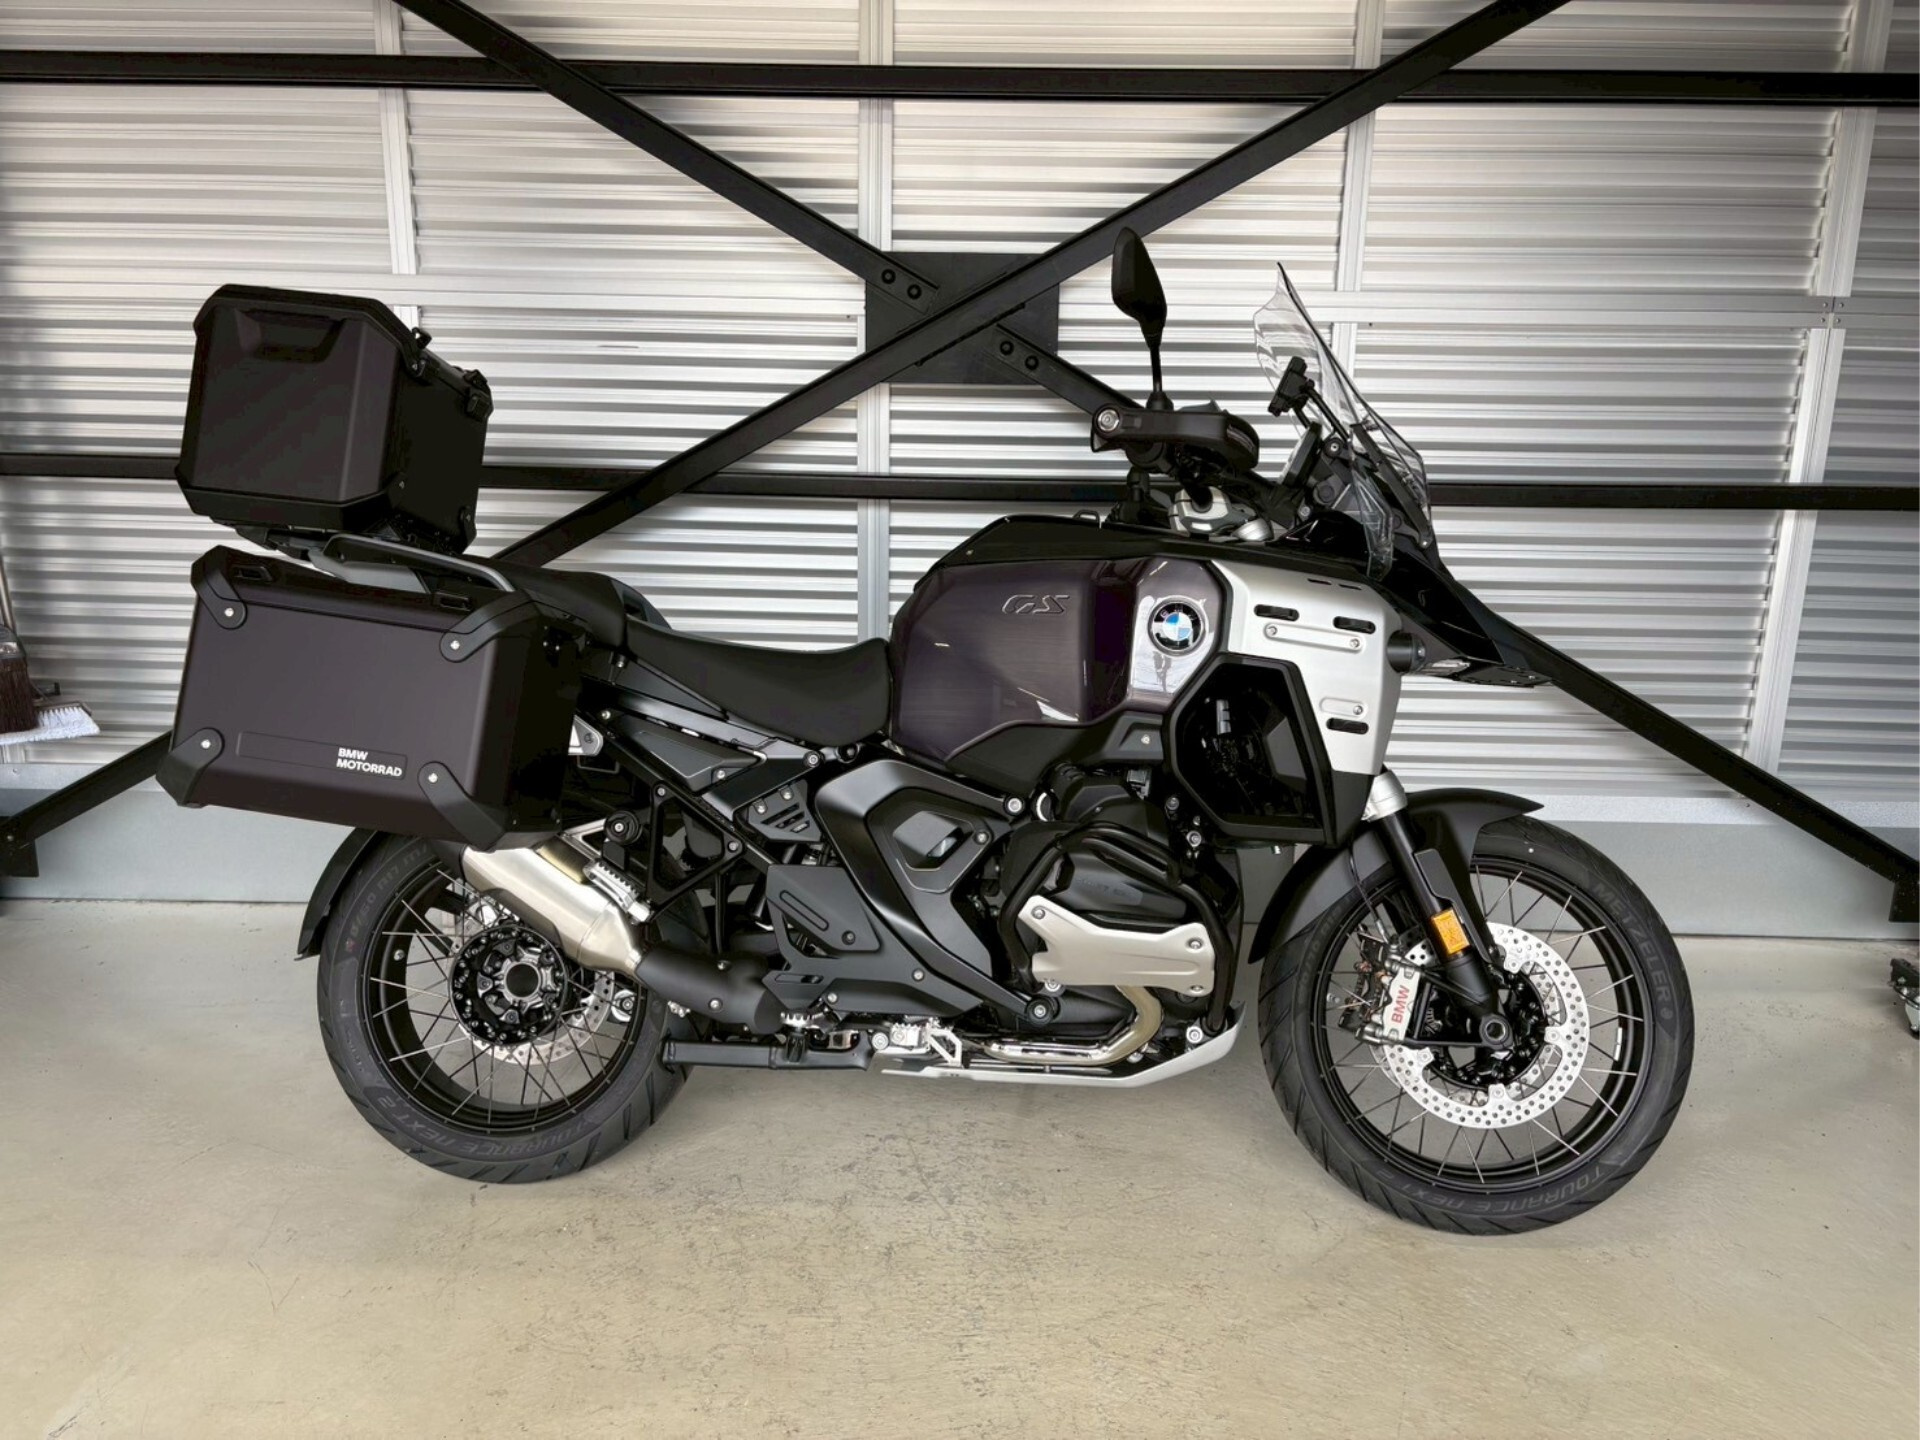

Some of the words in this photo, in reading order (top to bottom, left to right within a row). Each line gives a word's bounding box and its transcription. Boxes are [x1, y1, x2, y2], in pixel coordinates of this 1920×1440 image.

[1002, 594, 1070, 614] GS
[336, 758, 402, 777] MOTORRAD
[338, 747, 368, 760] BMW
[1593, 883, 1672, 1002] METZELER
[1391, 985, 1410, 1024] BMW
[461, 1117, 587, 1157] TOURANCE
[1473, 1166, 1605, 1212] TOURANCE
